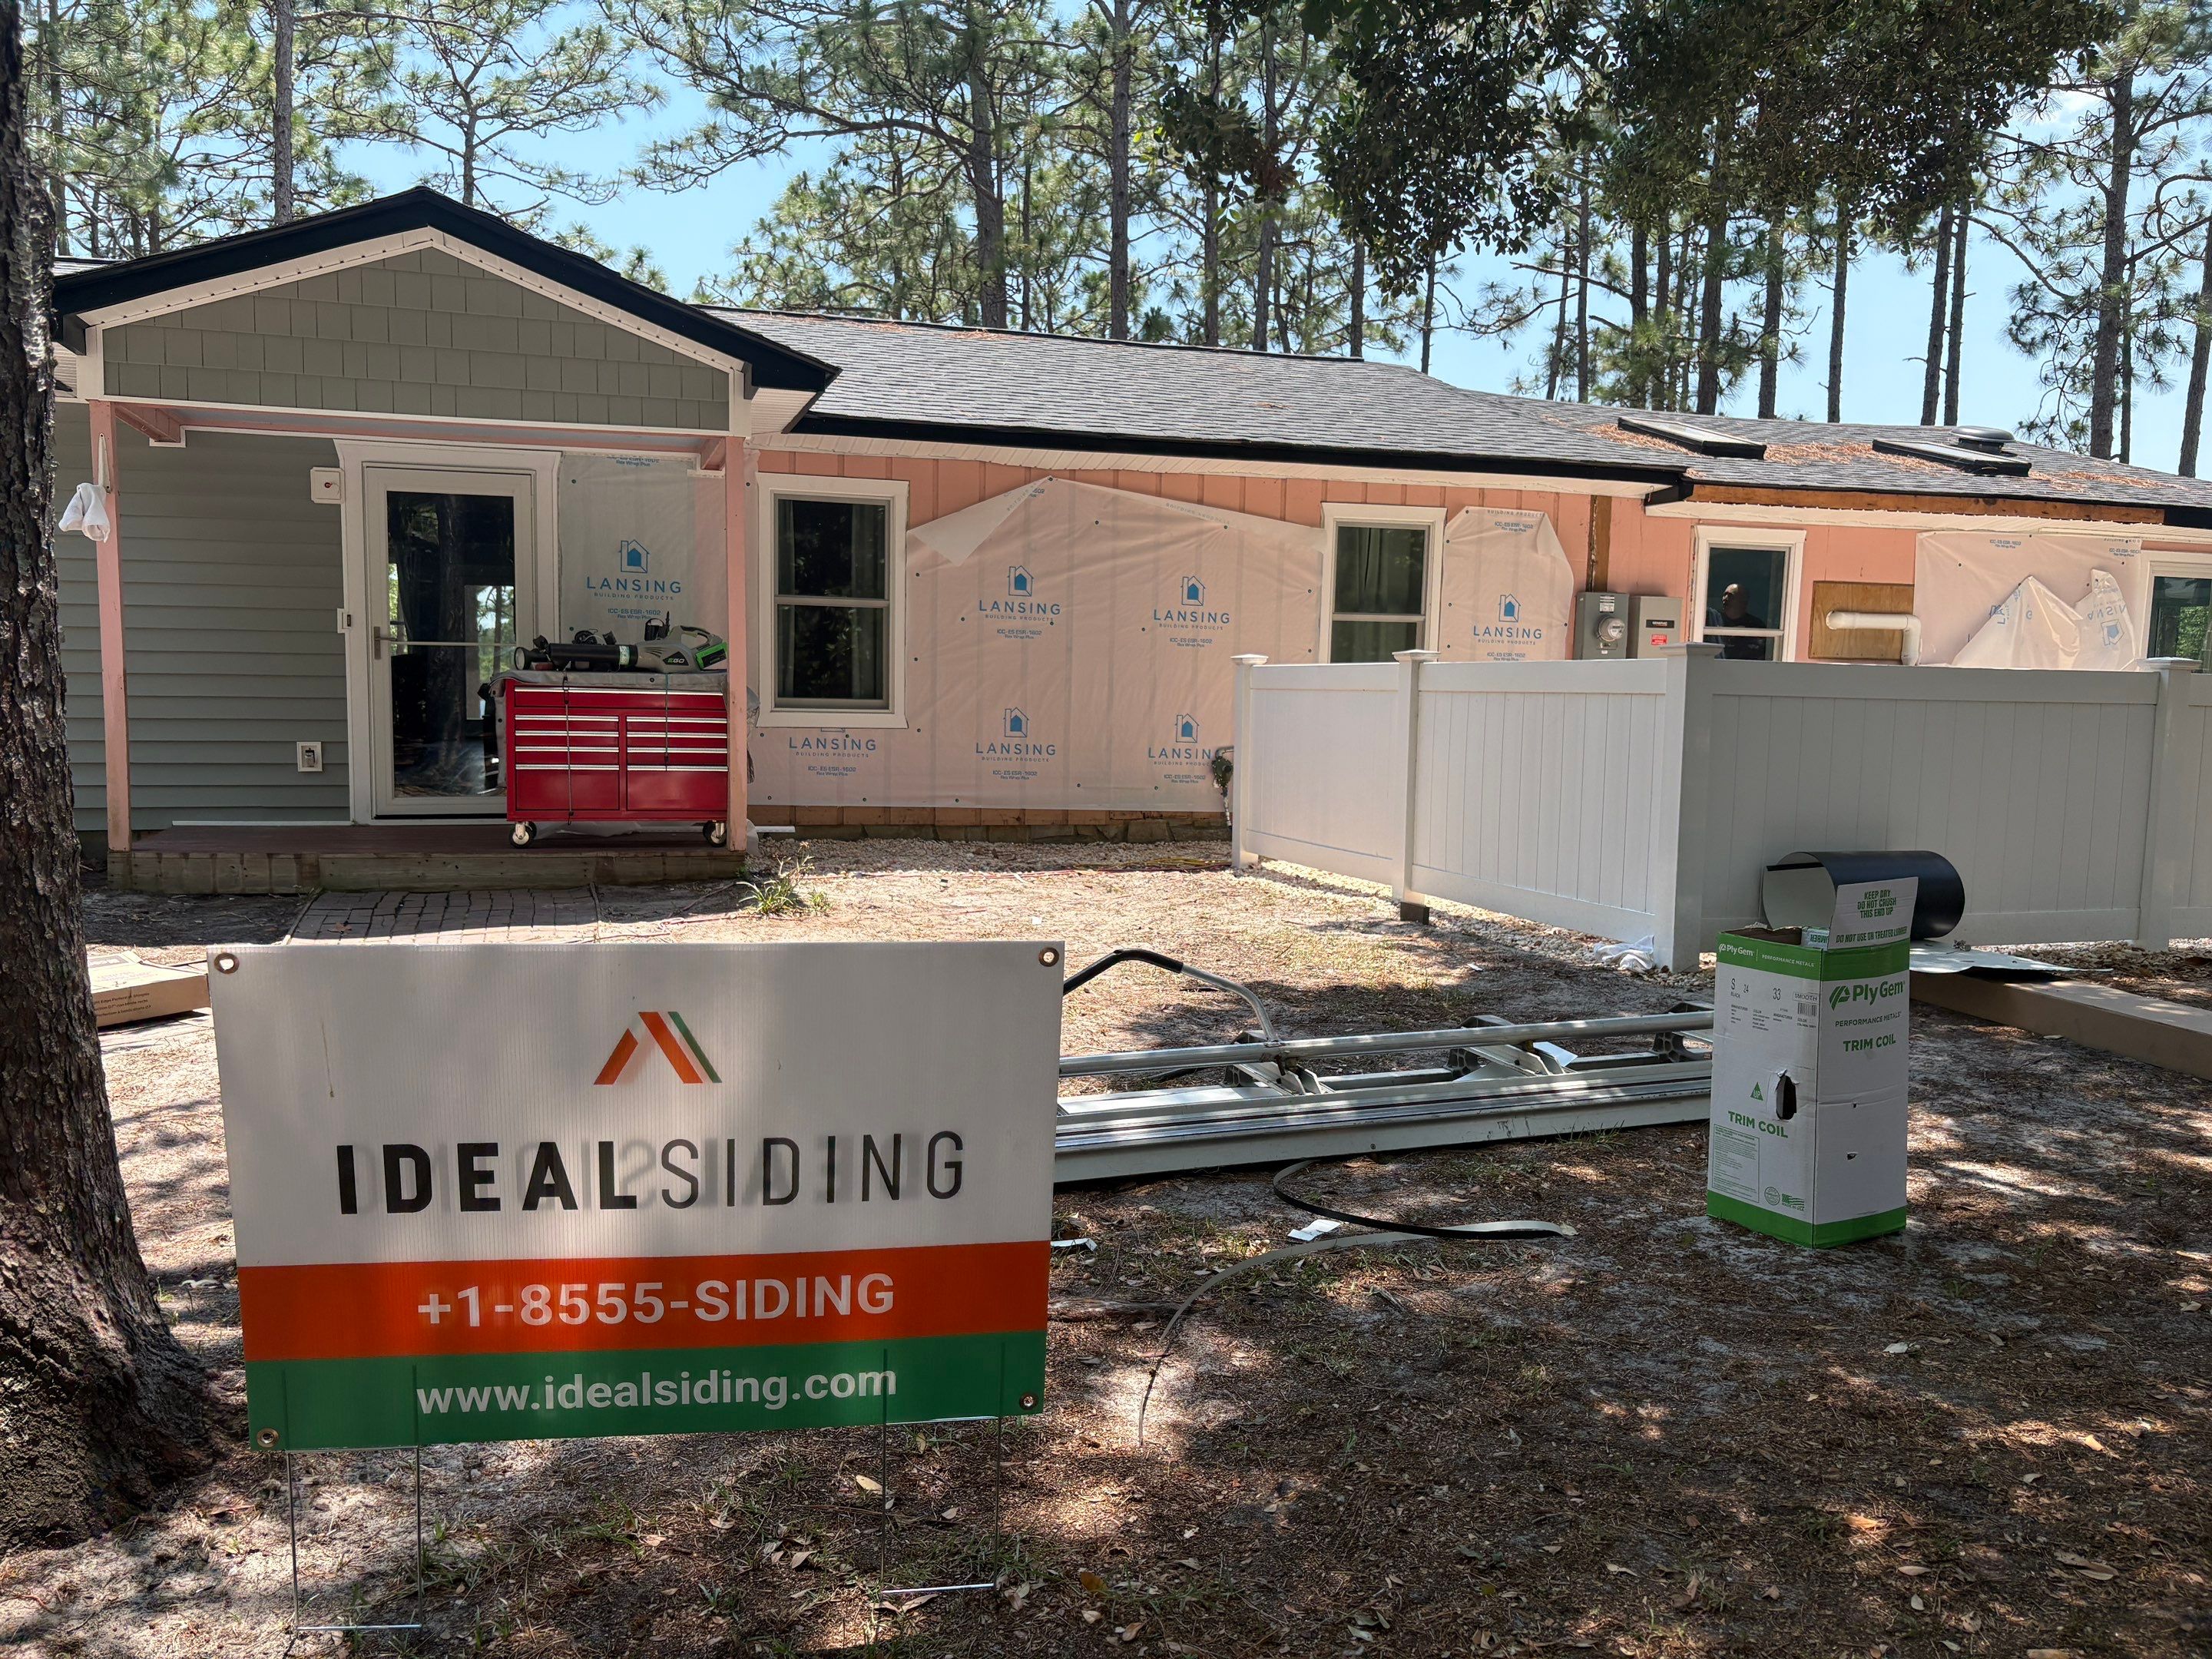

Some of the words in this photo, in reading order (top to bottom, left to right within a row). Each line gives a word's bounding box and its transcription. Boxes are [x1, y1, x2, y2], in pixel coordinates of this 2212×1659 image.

[586, 577, 681, 594] LANSING
[979, 600, 1061, 615] LANSING
[1154, 609, 1230, 624] LANSING
[1473, 625, 1541, 639] LANSING
[789, 737, 876, 751] LANSING
[975, 742, 1056, 756] LANSING
[1148, 747, 1211, 760] LANSIN
[1864, 890, 1879, 900] KEEP
[1879, 889, 1891, 899] DRY
[1857, 900, 1866, 910] DO
[1866, 899, 1878, 909] NOT
[1879, 897, 1897, 907] CRUSH
[1860, 909, 1873, 919] THIS
[1874, 908, 1885, 917] END
[1886, 907, 1893, 916] UP
[1836, 934, 1844, 943] DO
[1844, 933, 1856, 943] NOT
[1857, 932, 1867, 942] USE
[1737, 946, 1753, 957] Gem
[1761, 954, 1796, 965] PERFORMANCE
[1796, 959, 1814, 968] METALS
[1773, 988, 1781, 1001] 33
[1794, 992, 1817, 1002] SMOOTH
[1853, 984, 1879, 1006] Ply
[1879, 981, 1904, 998] Gem
[1835, 1015, 1883, 1027] PERFORMANCE
[1883, 1012, 1901, 1022] METALS
[1843, 1038, 1873, 1052] TRIM
[1876, 1033, 1896, 1048] COIL
[1753, 1089, 1761, 1099] UP
[1727, 1110, 1756, 1129] TRIM
[1758, 1121, 1789, 1139] COIL
[417, 1272, 895, 1327] +1-8555-SIDING
[416, 1369, 897, 1414] www.idealsiding.com
